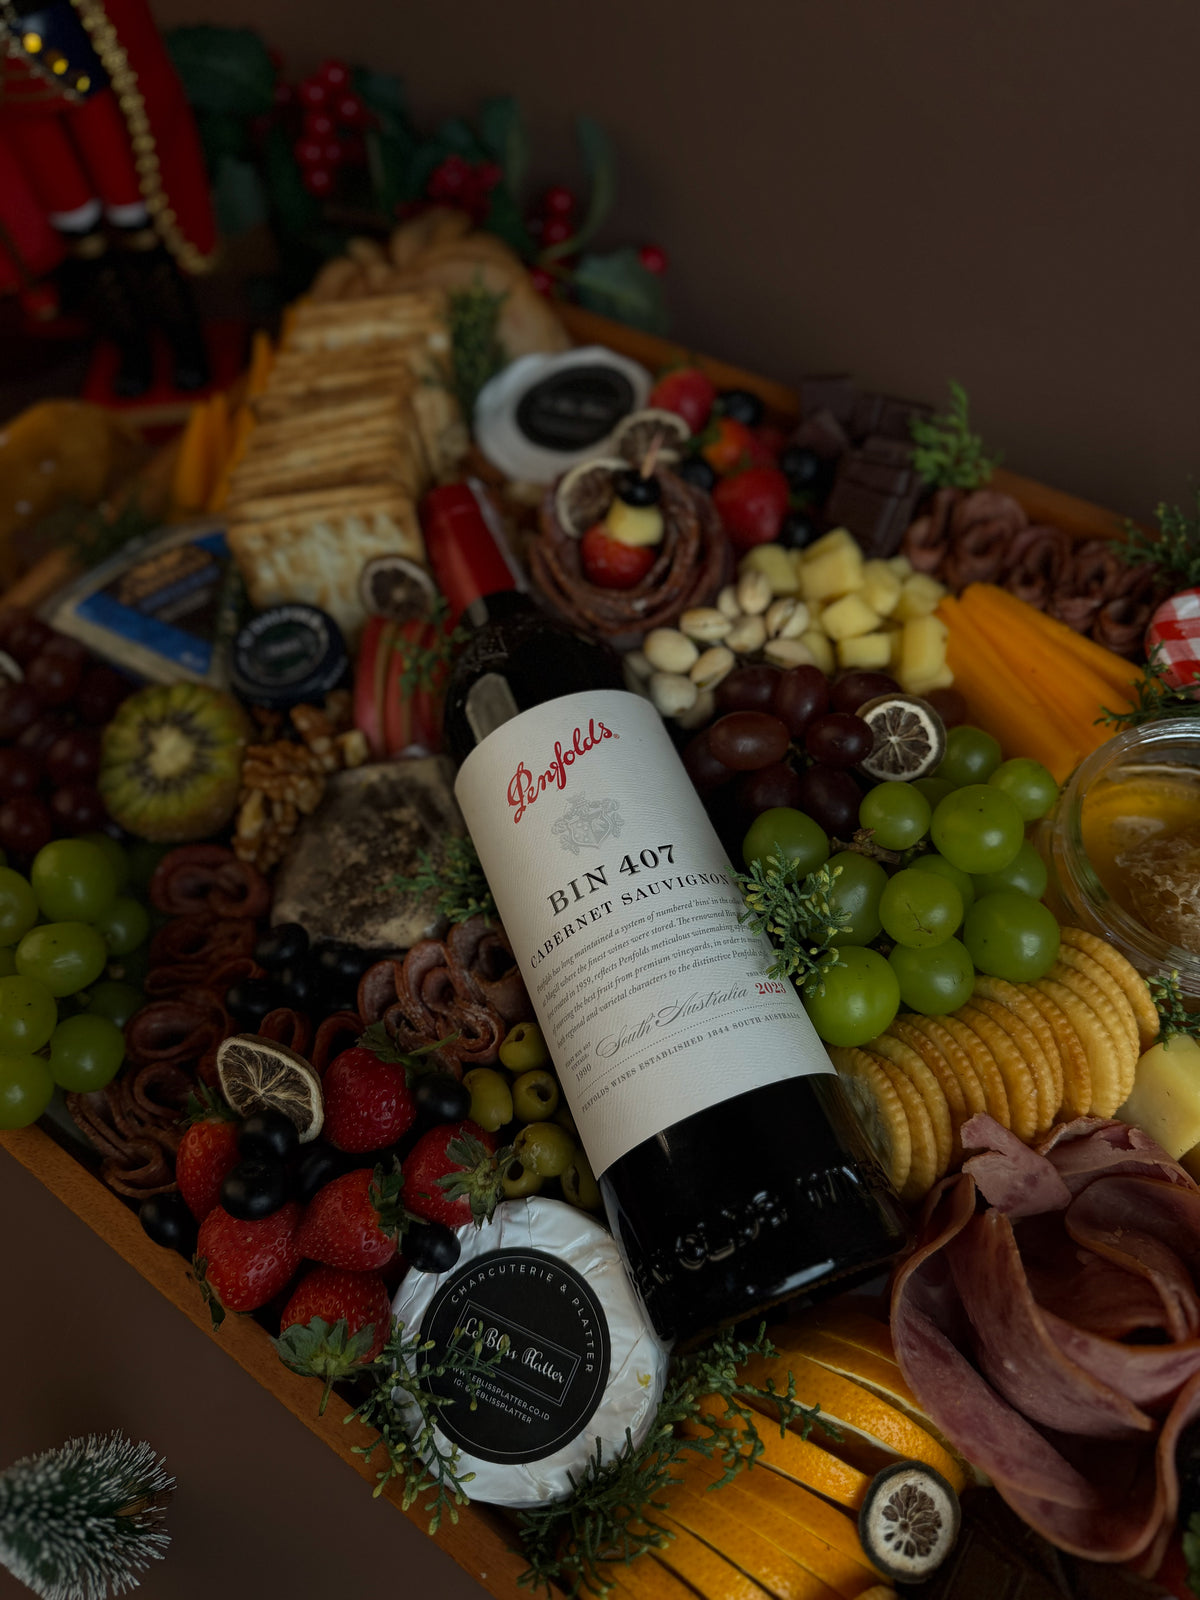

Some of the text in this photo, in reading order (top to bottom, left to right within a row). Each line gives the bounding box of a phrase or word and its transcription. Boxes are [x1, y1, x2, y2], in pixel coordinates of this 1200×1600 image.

[507, 718, 613, 824] Penfolds
[547, 844, 675, 916] BIN 407
[530, 872, 730, 969] CABERNET SAUVIGNON
[561, 955, 575, 970] long
[574, 928, 614, 958] maintained
[620, 916, 646, 934] system
[646, 909, 655, 922] of
[655, 901, 693, 918] numbered
[577, 964, 588, 975] the
[587, 951, 606, 971] finest
[607, 939, 630, 955] wines
[630, 930, 650, 943] were
[651, 920, 677, 935] stored.
[676, 916, 690, 926] The
[691, 909, 725, 922] renowned
[594, 961, 618, 981] reflects
[618, 945, 650, 967] Penfolds
[651, 932, 691, 951] meticulous
[691, 922, 735, 937] winemaking
[583, 991, 596, 1006] best
[596, 981, 614, 1000] fruit
[614, 971, 633, 989] from
[635, 956, 671, 979] premium
[671, 940, 714, 959] vineyards,
[723, 936, 740, 945] order
[586, 1006, 599, 1022] and
[599, 989, 628, 1012] varietal
[628, 971, 668, 996] characters
[668, 967, 677, 978] to
[678, 961, 692, 973] the
[692, 952, 732, 969] distinctive
[655, 982, 749, 1028] Australia
[754, 981, 787, 995] 2023
[611, 1067, 637, 1089] WINES
[638, 1033, 704, 1072] ESTABLISHED
[708, 1025, 730, 1039] 1844
[732, 1016, 762, 1030] SOUTH
[451, 1263, 596, 1374] CHARCUTERIE & PLATTER
[483, 1327, 518, 1361] Blss
[521, 1347, 567, 1385] Platter
